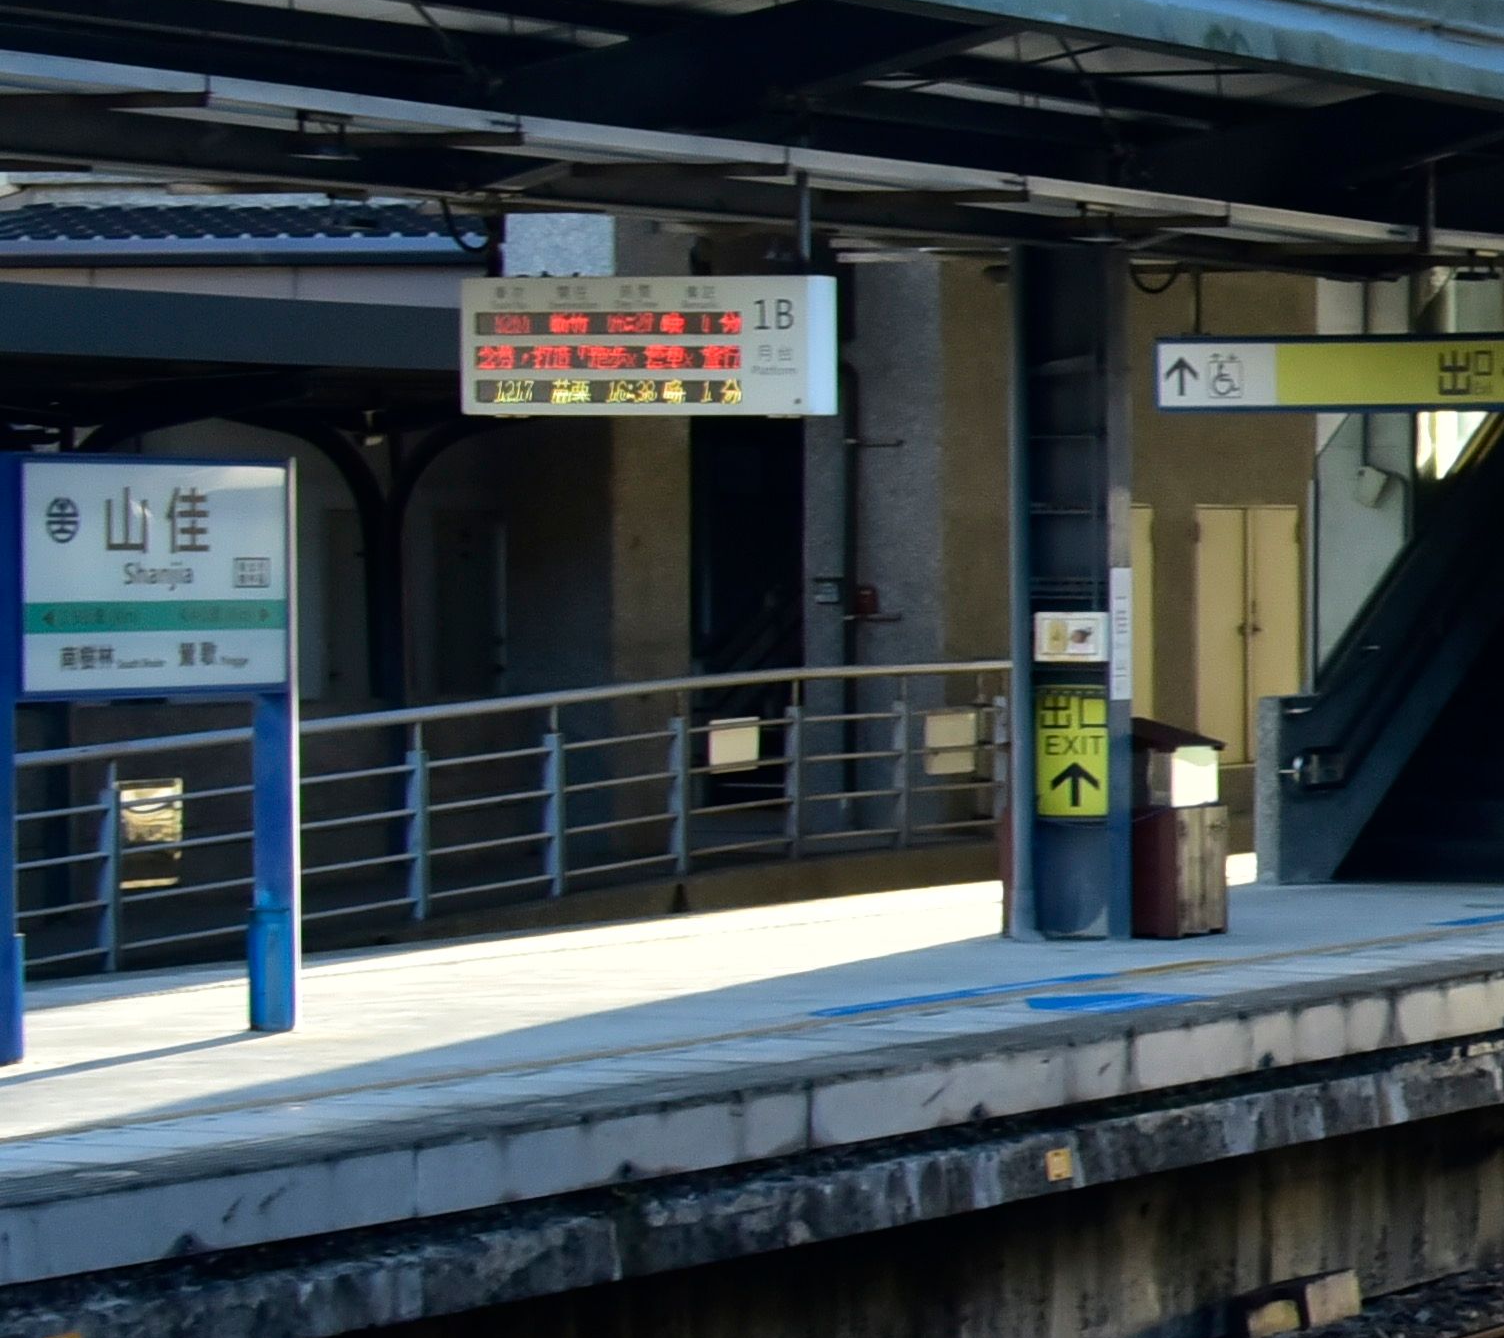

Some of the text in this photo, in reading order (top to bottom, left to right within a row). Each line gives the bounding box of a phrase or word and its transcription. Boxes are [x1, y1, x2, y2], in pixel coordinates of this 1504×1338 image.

[753, 299, 795, 330] 1B
[1438, 350, 1493, 395] 出口
[105, 486, 210, 554] 山佳
[124, 562, 194, 592] Shanjia
[1040, 694, 1108, 729] 出口
[1044, 735, 1105, 755] EXIT
